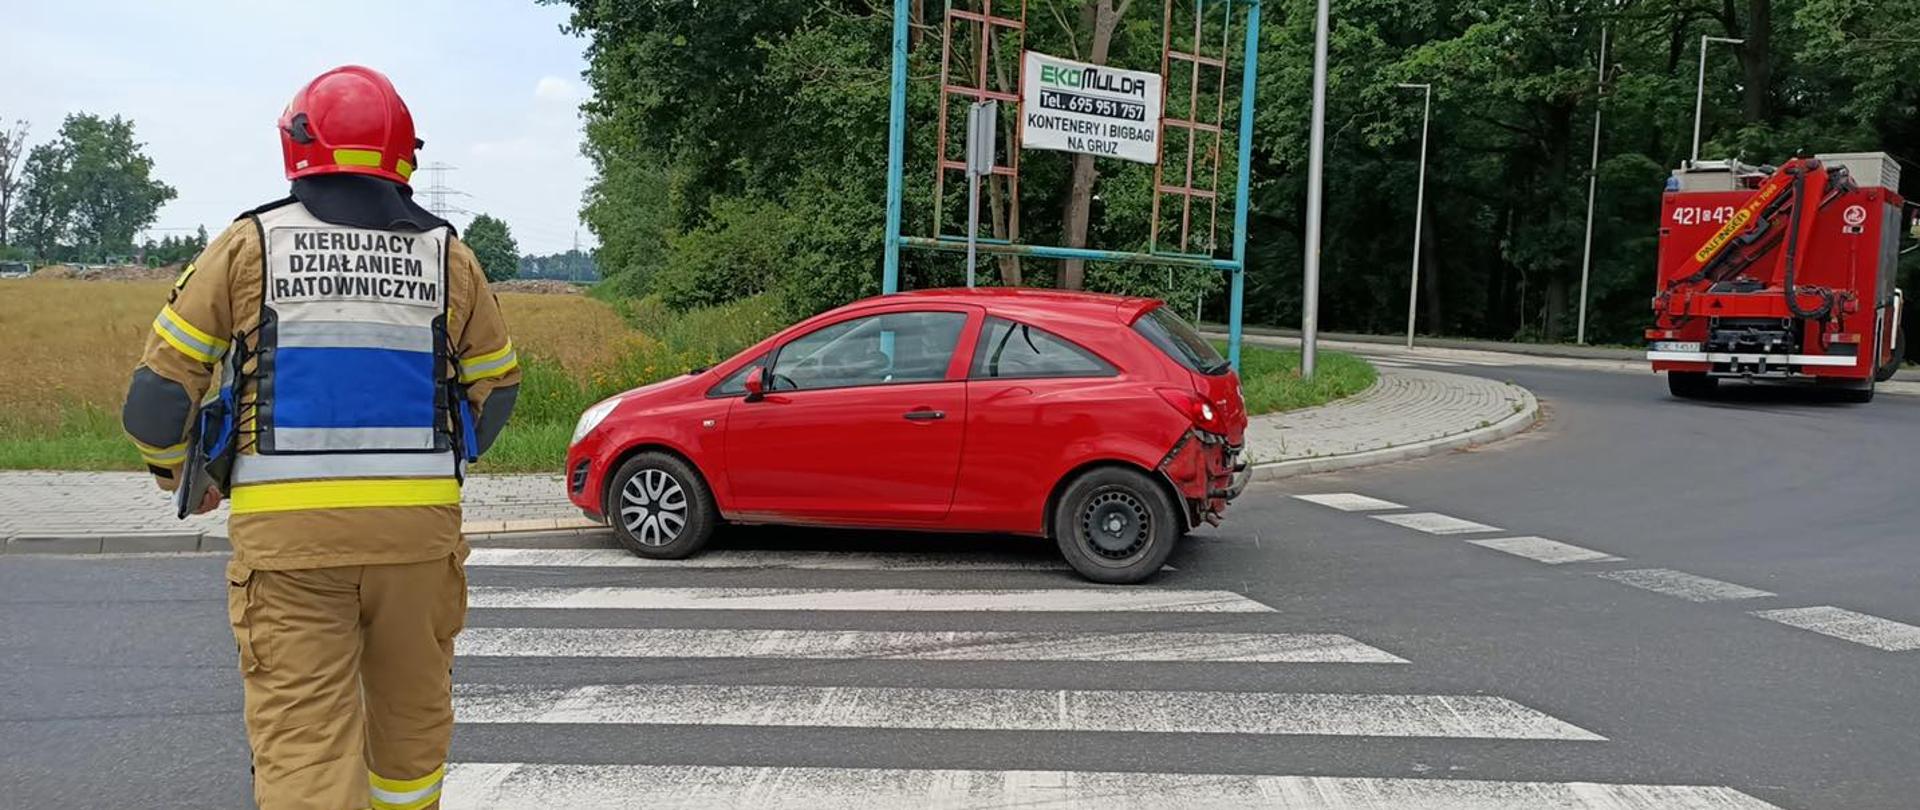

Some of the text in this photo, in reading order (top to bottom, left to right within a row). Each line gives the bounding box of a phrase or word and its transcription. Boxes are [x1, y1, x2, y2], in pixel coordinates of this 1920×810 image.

[1040, 64, 1146, 98] EKOMULDA
[1041, 92, 1144, 119] Tel. 695 951 757
[1028, 113, 1155, 142] KONTENERY I BIGBAGI
[1067, 137, 1119, 155] NA GRUZ
[1672, 207, 1702, 225] 421
[1698, 211, 1748, 259] PALFINGER
[289, 254, 423, 277] DZIAŁANIEM
[275, 277, 437, 301] RATOWNICZYM
